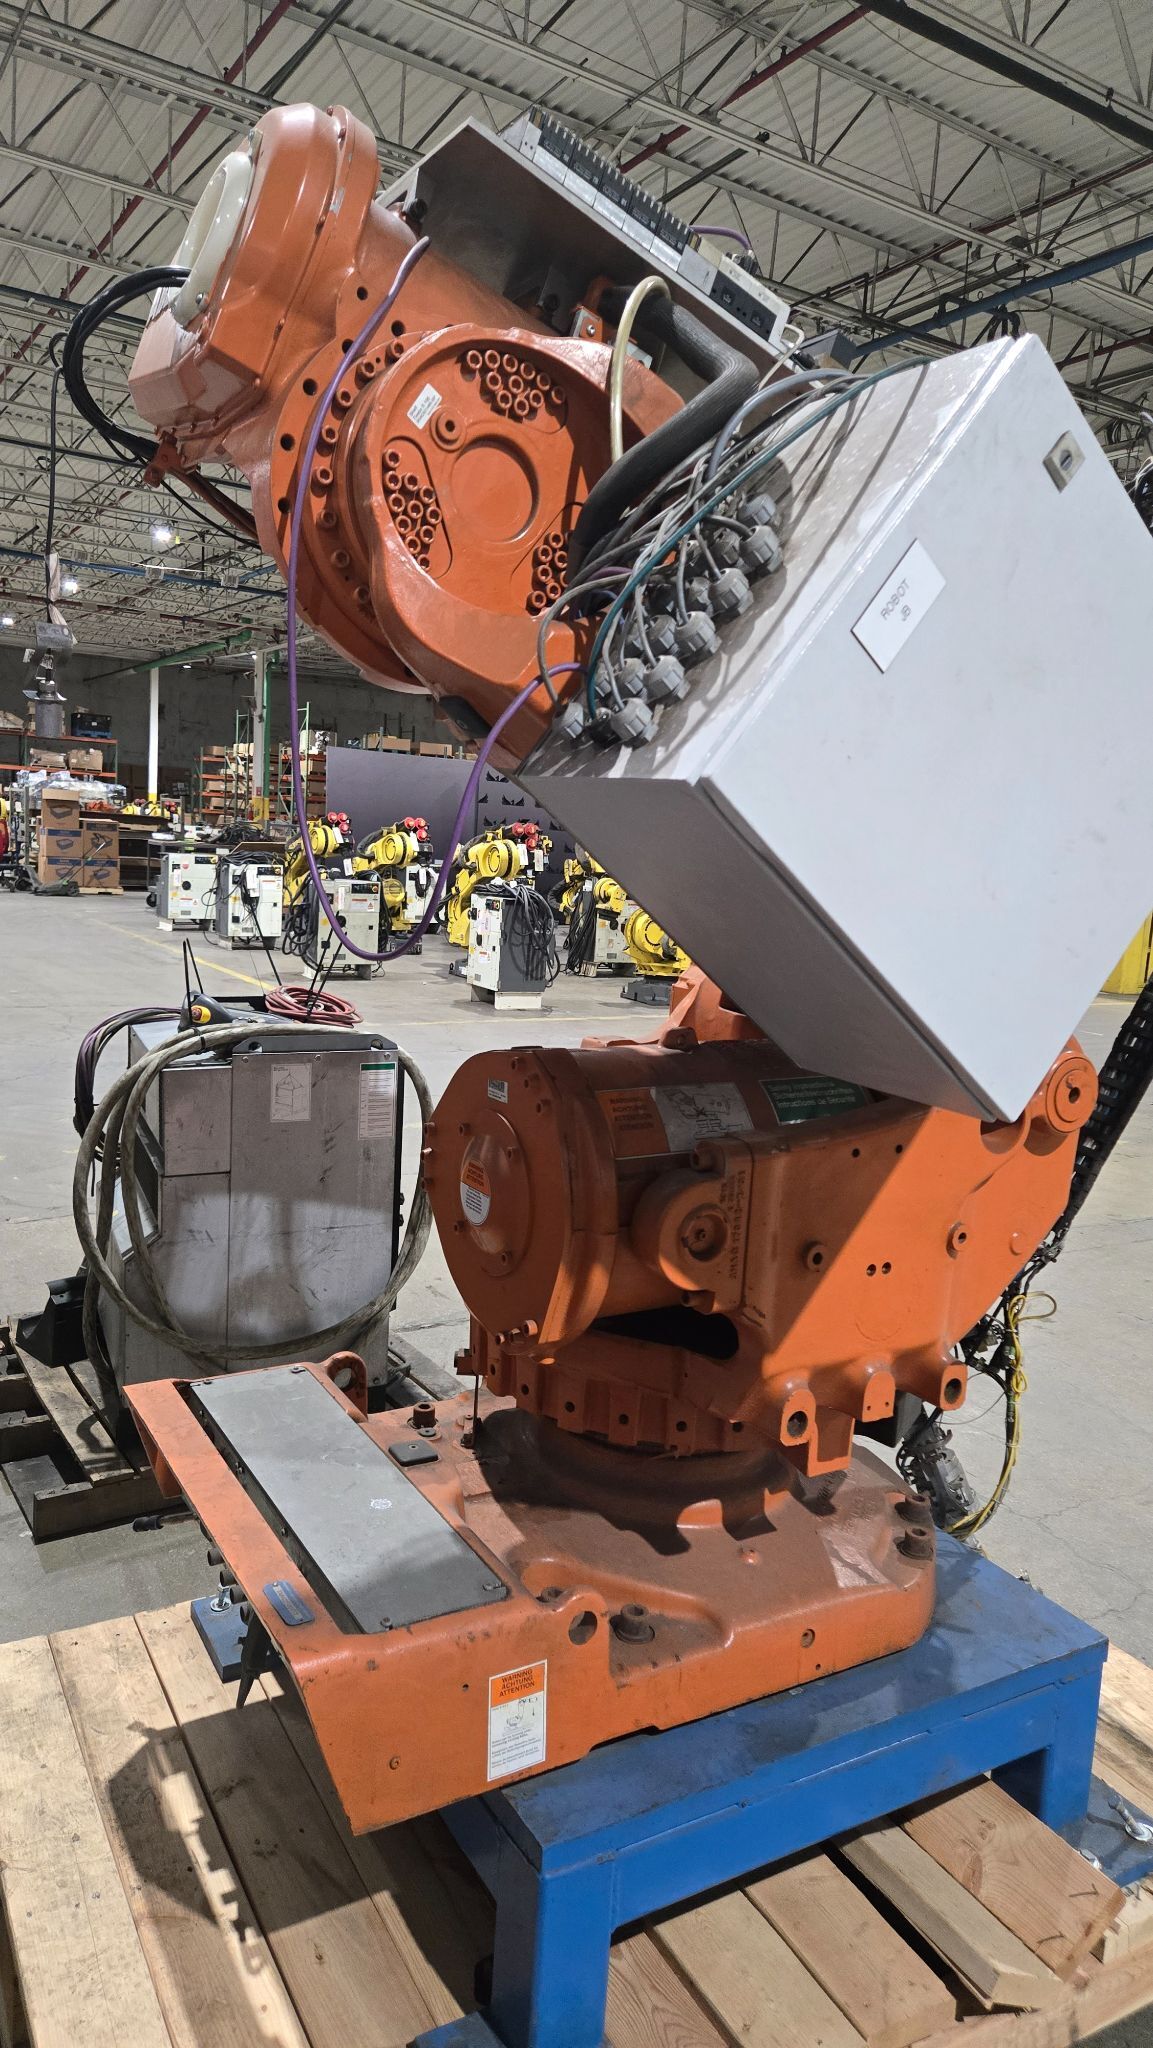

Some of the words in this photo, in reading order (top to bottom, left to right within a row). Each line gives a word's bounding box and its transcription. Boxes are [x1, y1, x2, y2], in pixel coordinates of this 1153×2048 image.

[880, 578, 910, 620] ROBOT
[501, 1668, 533, 1683] WARNING
[501, 1675, 534, 1690] ACHTUNG
[499, 1682, 535, 1697] ATTENTION
